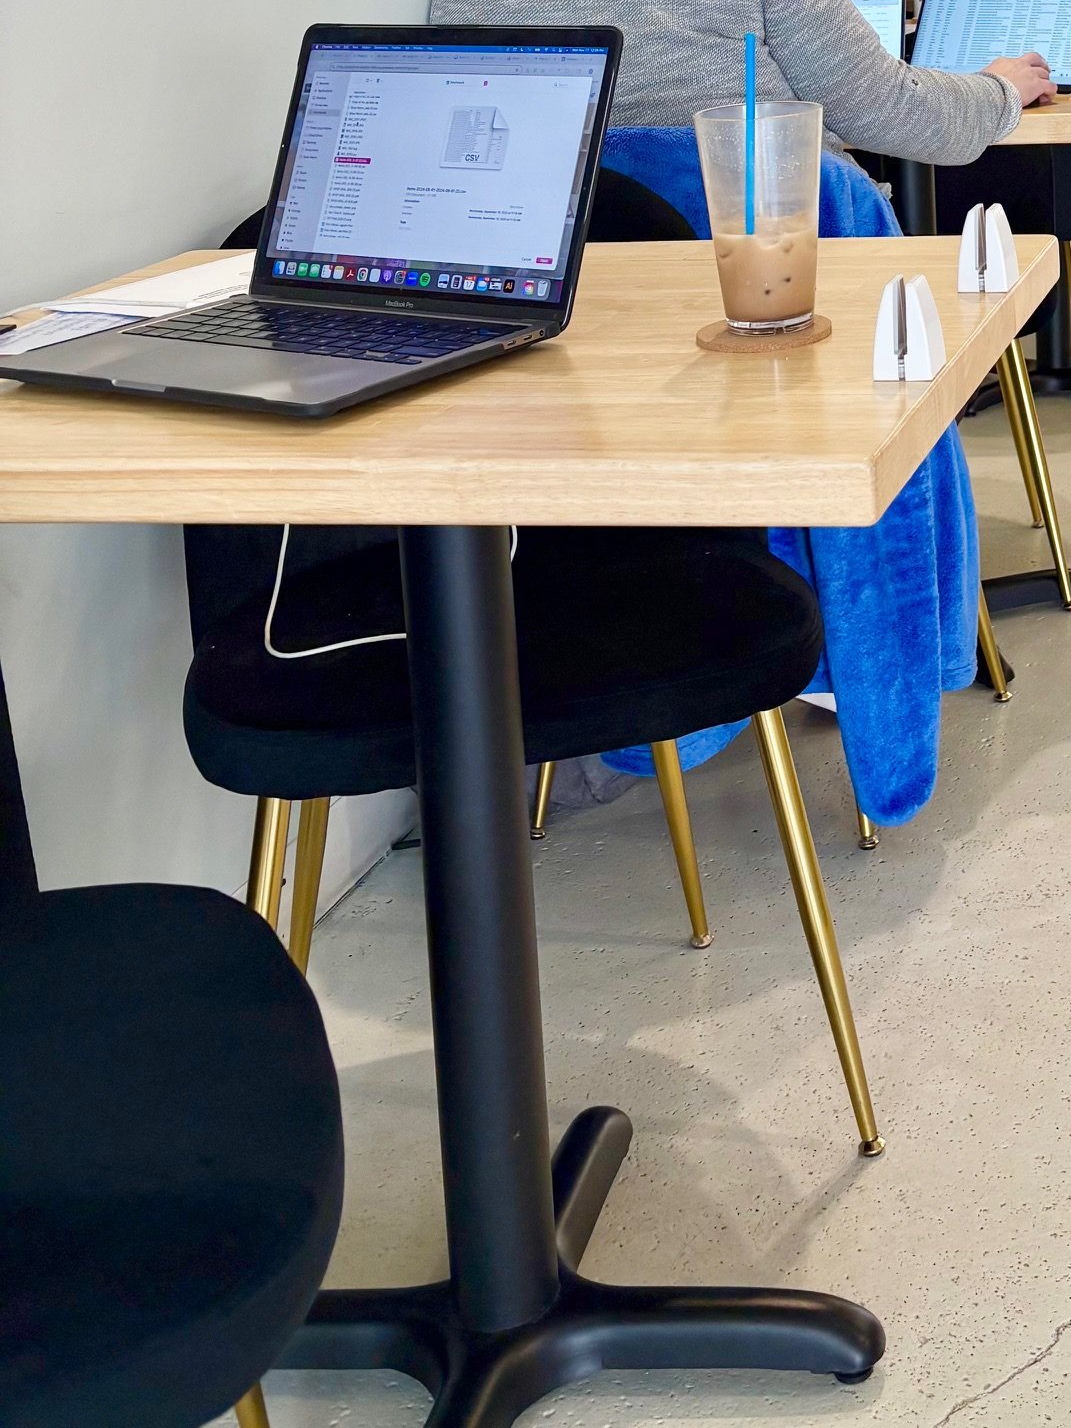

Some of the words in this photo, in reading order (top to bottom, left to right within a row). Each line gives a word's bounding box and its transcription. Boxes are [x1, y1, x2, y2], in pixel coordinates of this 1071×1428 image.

[465, 154, 480, 162] CSV
[385, 300, 405, 308] MacBook
[406, 301, 414, 309] Pro
